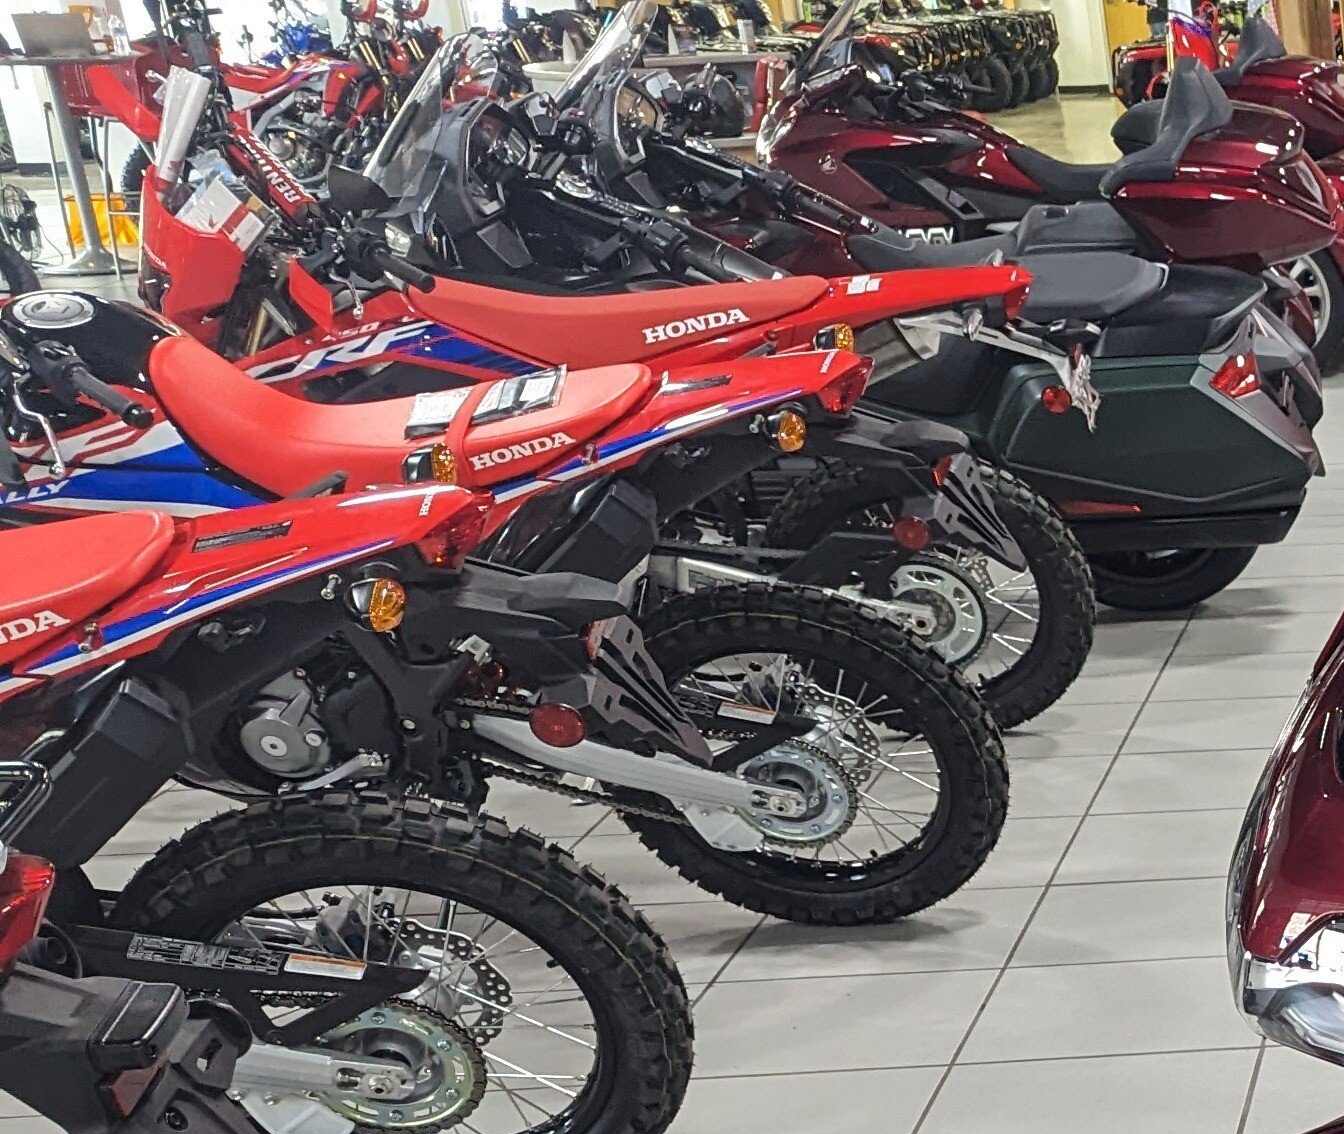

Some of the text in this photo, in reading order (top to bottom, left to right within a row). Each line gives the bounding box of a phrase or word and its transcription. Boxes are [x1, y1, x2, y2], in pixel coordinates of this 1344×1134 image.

[642, 308, 750, 344] HONDA
[469, 432, 576, 470] HONDA
[0, 480, 70, 504] LLY
